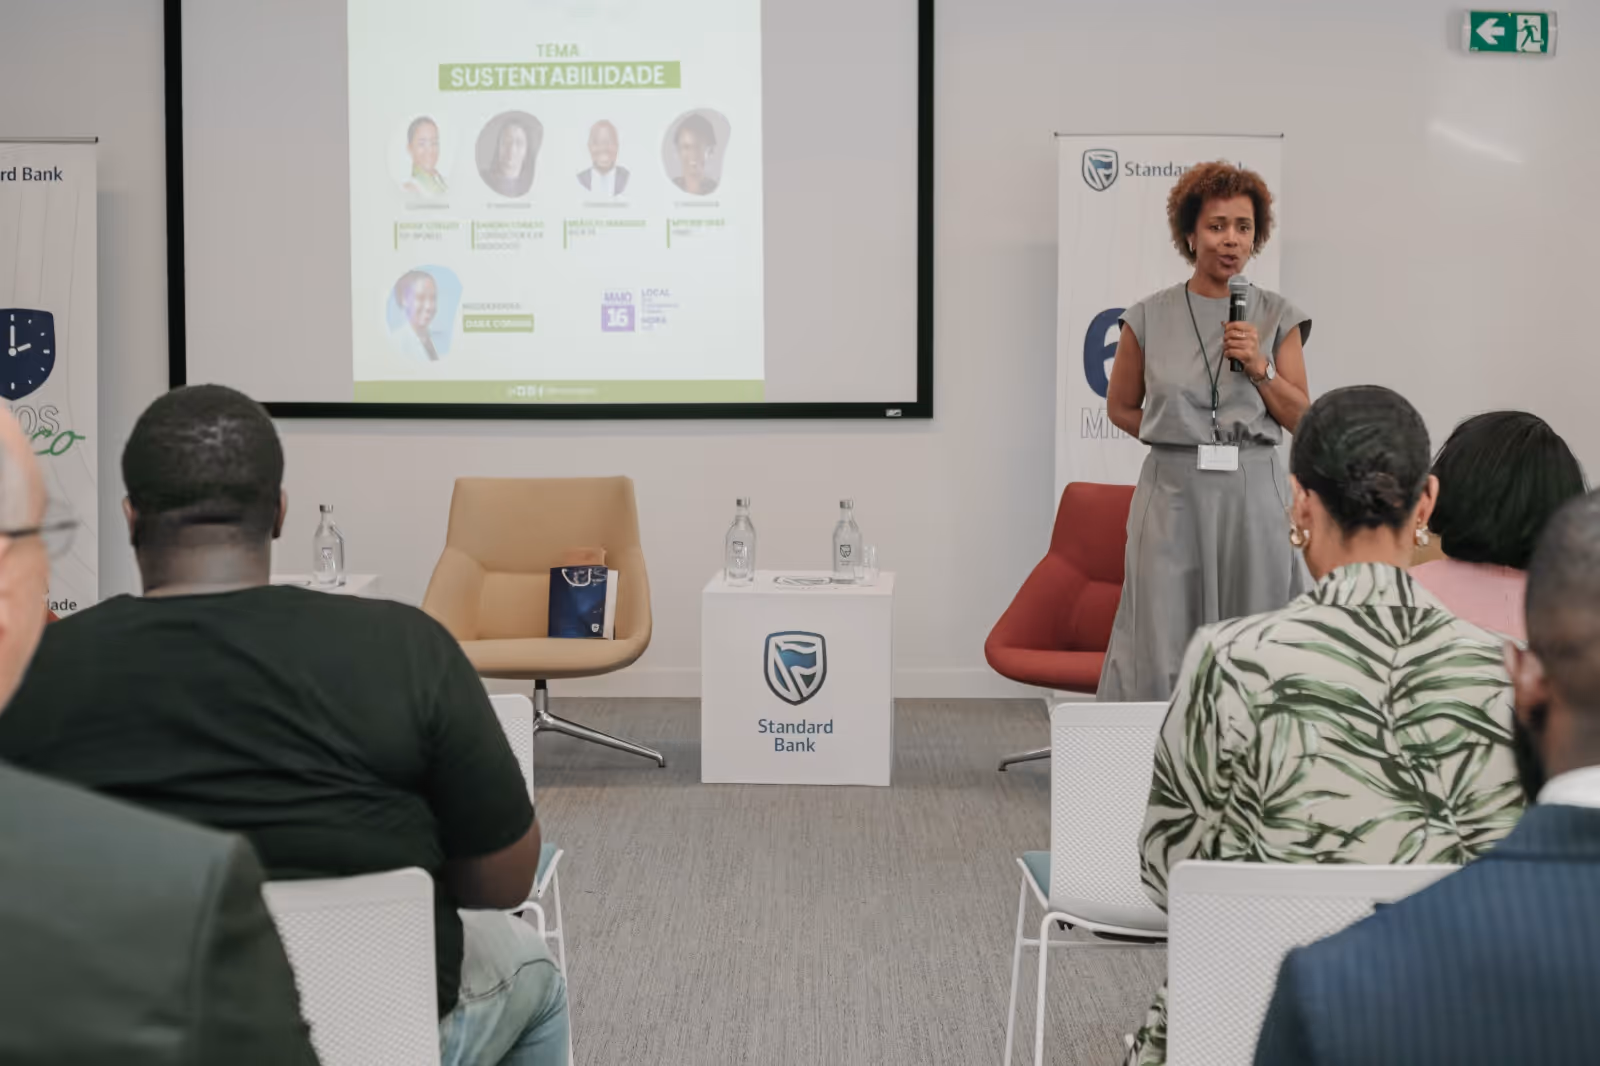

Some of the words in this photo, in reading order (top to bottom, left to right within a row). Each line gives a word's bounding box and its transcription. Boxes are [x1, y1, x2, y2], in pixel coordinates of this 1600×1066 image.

[536, 43, 580, 58] TEMA
[450, 64, 666, 88] SUSTENTABILIDADE
[22, 166, 63, 182] Bank
[1124, 160, 1190, 177] Standa
[604, 290, 632, 302] MAIO
[641, 288, 671, 298] LOCAL
[607, 307, 629, 327] 16
[758, 718, 834, 735] Standard
[774, 737, 816, 753] Bank
